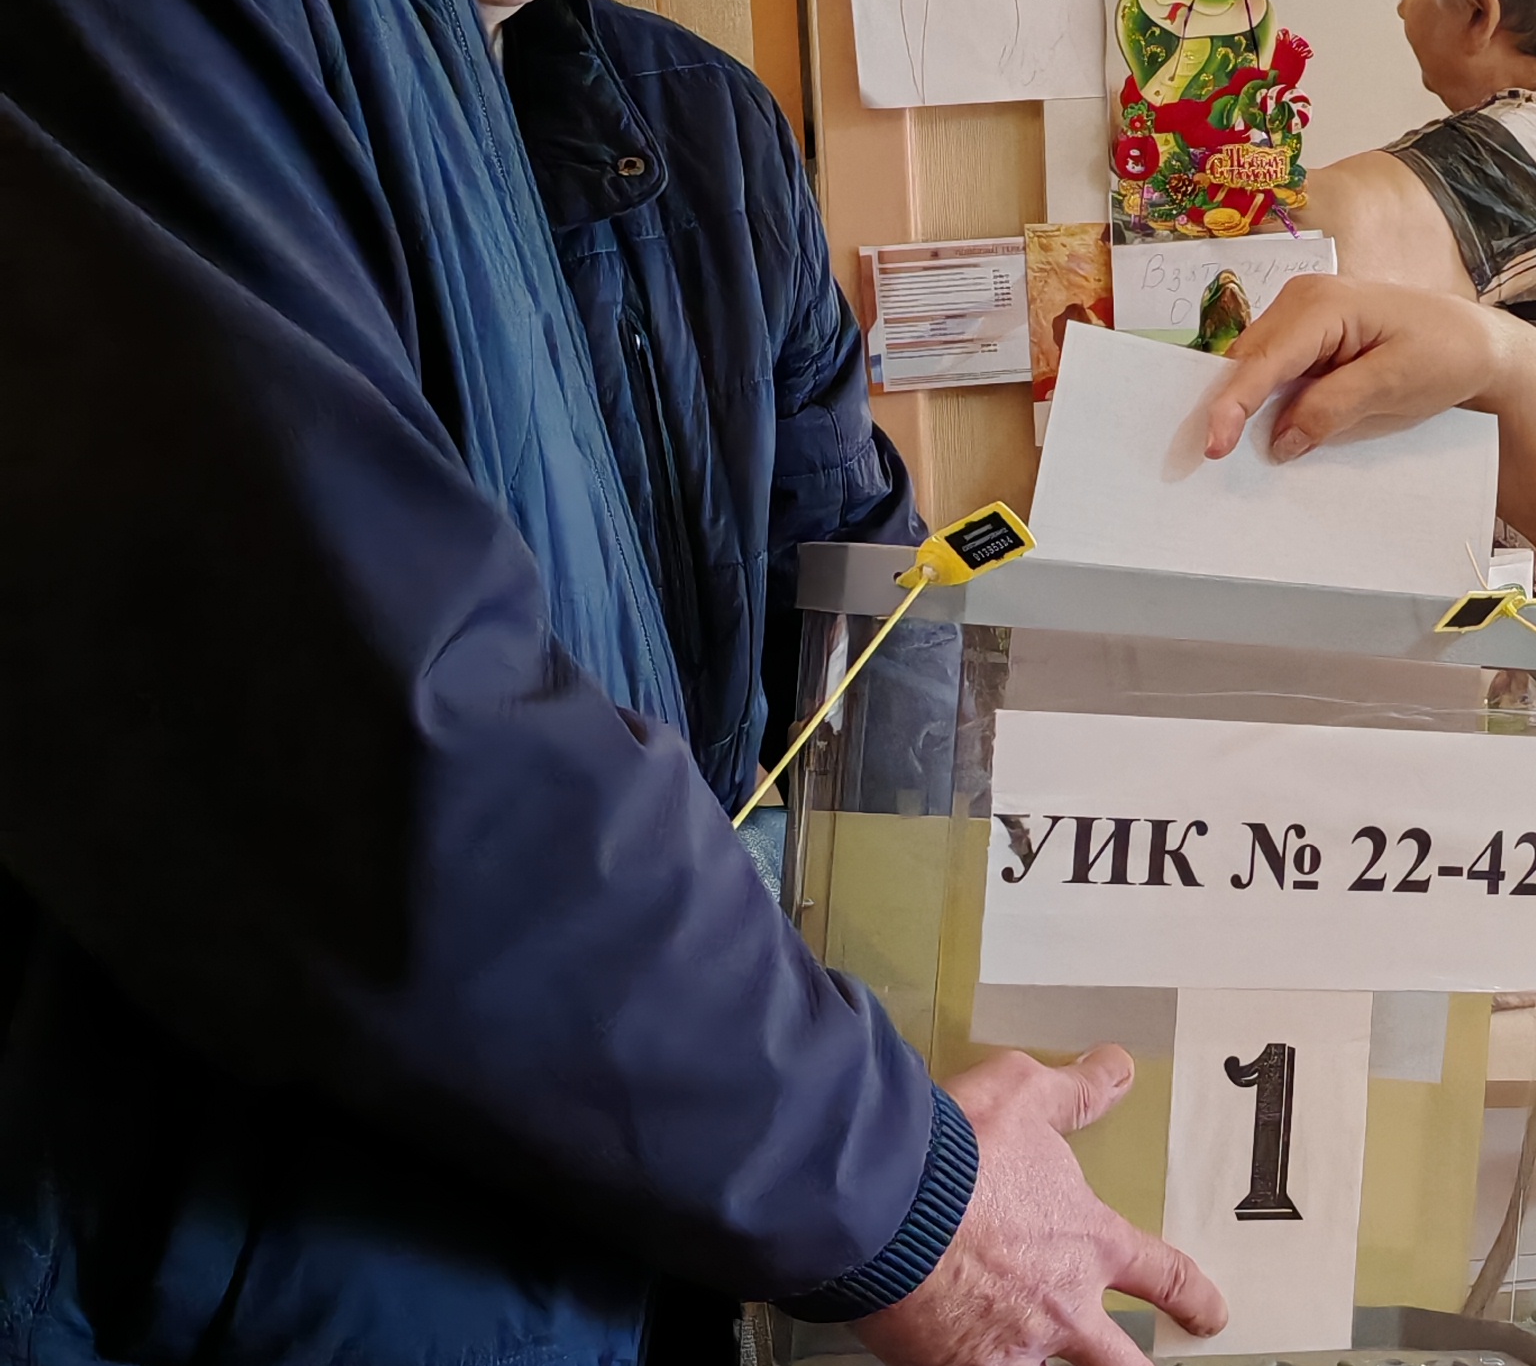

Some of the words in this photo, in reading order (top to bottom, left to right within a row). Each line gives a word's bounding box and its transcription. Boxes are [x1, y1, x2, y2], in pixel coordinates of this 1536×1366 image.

[993, 814, 1209, 887] УИК
[1230, 821, 1322, 891] №
[1224, 1043, 1303, 1221] 1
